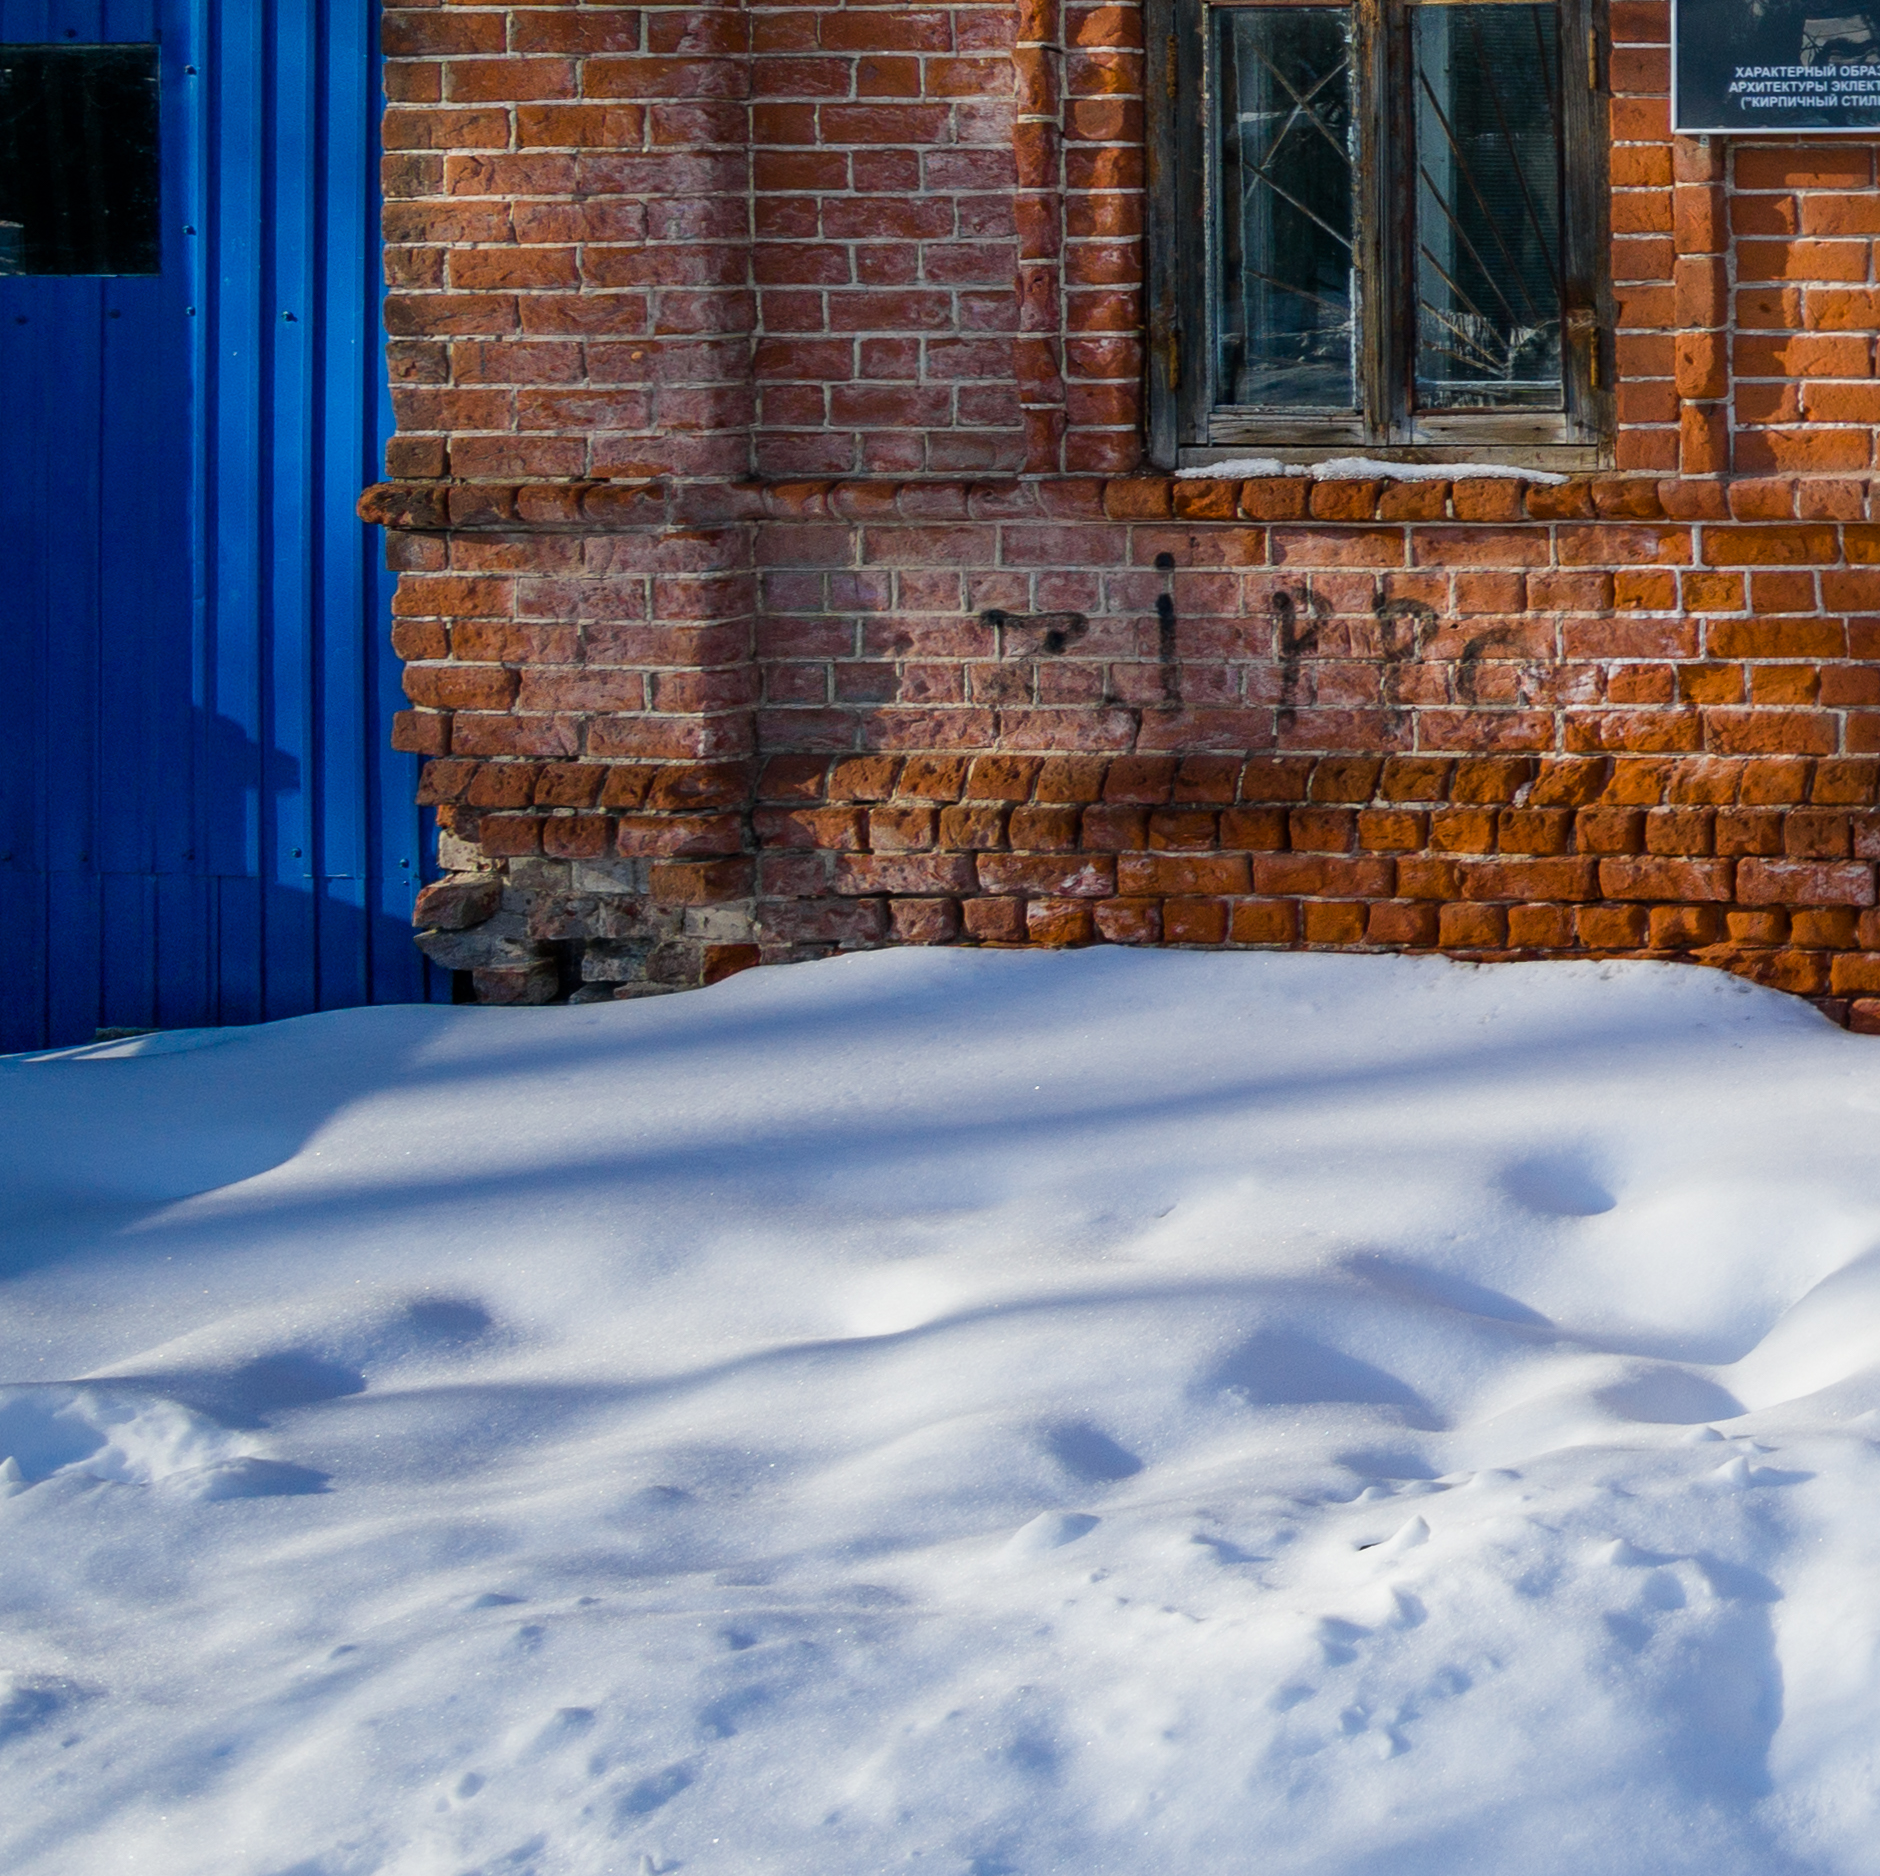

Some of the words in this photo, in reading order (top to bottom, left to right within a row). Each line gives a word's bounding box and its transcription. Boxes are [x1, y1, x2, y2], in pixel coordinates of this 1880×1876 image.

[1734, 64, 1837, 78] ХАРАКТЕРНЫЙ
[1729, 81, 1827, 93] АРХИТЕКТУРЫ
[1740, 94, 1838, 110] ("КИРПИЧНЫЙ
